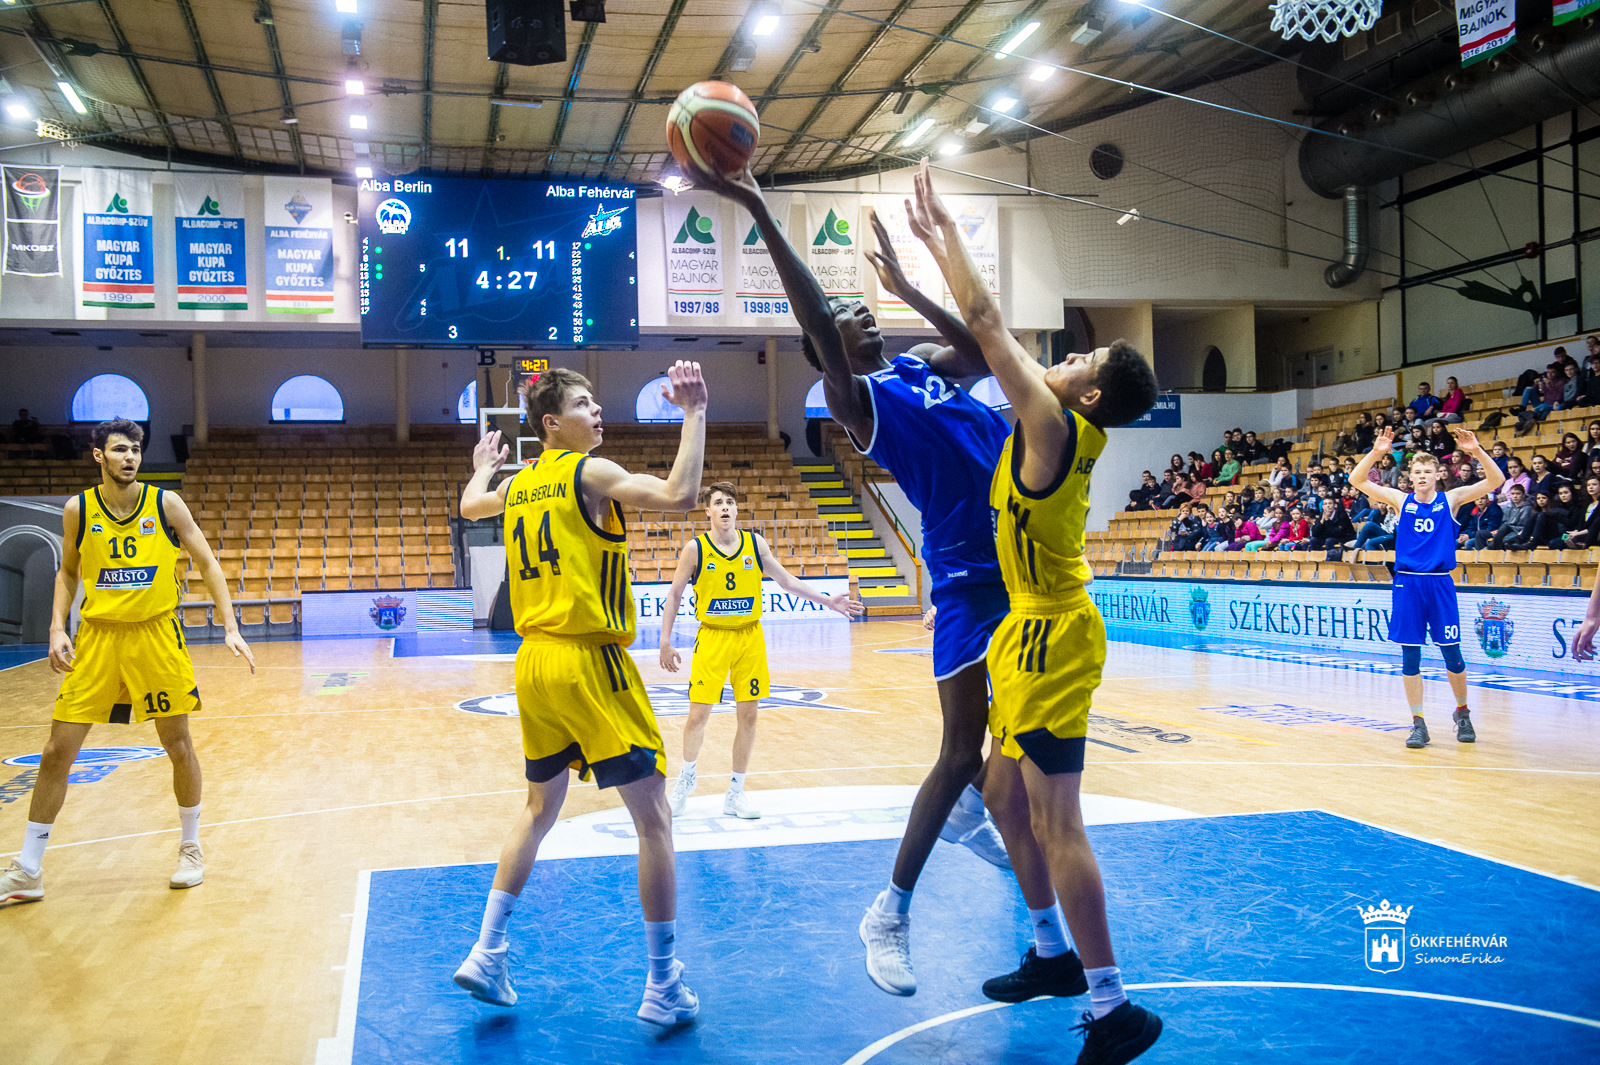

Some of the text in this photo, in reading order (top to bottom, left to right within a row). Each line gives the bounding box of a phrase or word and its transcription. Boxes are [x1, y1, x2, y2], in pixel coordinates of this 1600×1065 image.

[1459, 0, 1499, 20] MAGYA
[1459, 6, 1508, 36] BAJNOK
[360, 179, 433, 193] Alba Berlin
[546, 184, 636, 199] Alba Fehérvár
[182, 220, 238, 229] ALBACOMP-UPC
[270, 229, 328, 239] ALBA FEHÉRVÁR
[96, 240, 140, 252] MAGYAR
[362, 236, 369, 245] 4
[572, 242, 582, 250] 17
[11, 243, 55, 252] MKOSZ
[189, 243, 233, 254] MAGYAR
[362, 245, 369, 254] 7
[445, 238, 469, 258] 11
[496, 245, 511, 260] 1.
[532, 240, 556, 260] 11
[104, 253, 134, 266] KUPA
[277, 248, 322, 260] MAGYAR
[571, 250, 582, 259] 22
[628, 251, 635, 260] 4
[198, 256, 226, 268] KUPA
[285, 263, 315, 273] KUPA
[360, 263, 370, 271] 12
[571, 259, 582, 267] 27
[670, 259, 719, 270] MAGYAR
[95, 265, 142, 280] GYŐZTES
[420, 264, 426, 273] 5
[741, 266, 778, 276] MAGYA
[811, 265, 857, 276] MAGYAR
[189, 268, 235, 282] GYŐZTES
[275, 274, 325, 287] GYŐZTES
[476, 270, 538, 290] 4:27
[629, 276, 636, 285] 5
[672, 272, 718, 283] BAJNOK
[360, 280, 370, 289] 14
[572, 284, 582, 292] 41
[820, 279, 857, 290] AJNOK
[360, 289, 370, 297] 15
[572, 293, 583, 301] 42
[420, 298, 427, 307] 4
[572, 301, 583, 309] 43
[674, 301, 719, 314] 1997/98
[744, 301, 789, 314] 1998/99
[360, 306, 371, 315] 17
[420, 307, 427, 316] 2
[572, 318, 583, 326] 50
[630, 318, 637, 327] 2
[448, 325, 458, 339] 3
[548, 327, 558, 340] 2
[477, 349, 497, 366] B
[521, 359, 548, 372] 4:27
[911, 375, 956, 409] 22
[530, 482, 567, 503] BERLIN
[1414, 518, 1435, 533] 50
[108, 536, 137, 559] 16
[512, 510, 562, 581] 14
[725, 571, 736, 591] 8
[1444, 625, 1459, 640] 50
[749, 678, 760, 697] 8
[143, 691, 171, 713] 16
